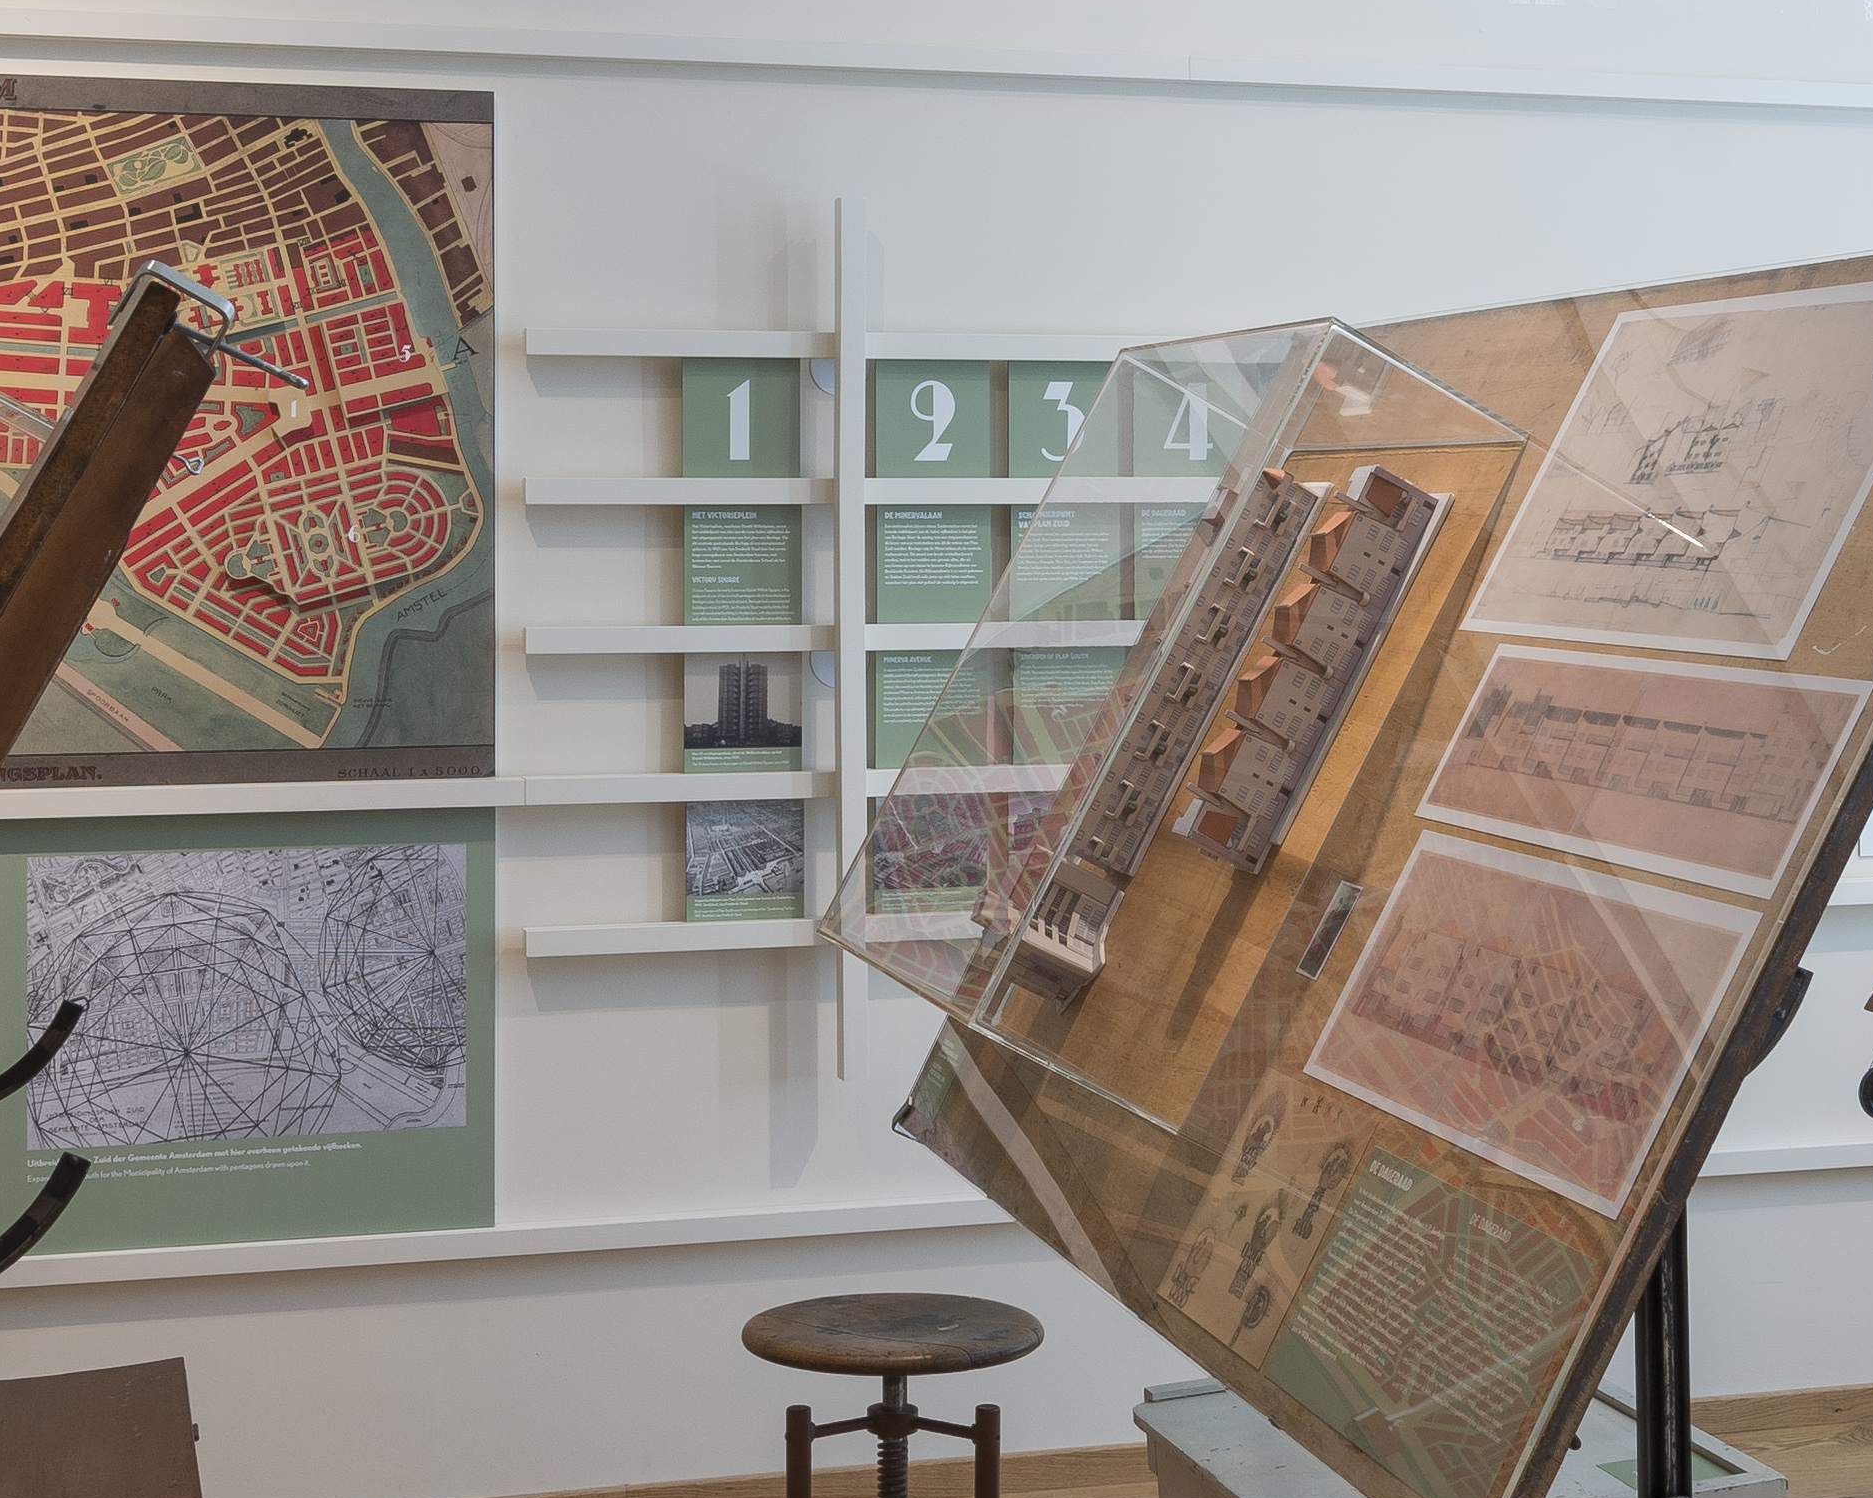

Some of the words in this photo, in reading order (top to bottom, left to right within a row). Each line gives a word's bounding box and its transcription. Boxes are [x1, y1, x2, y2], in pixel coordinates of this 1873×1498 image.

[399, 344, 411, 362] 5
[726, 379, 751, 461] 1
[909, 380, 958, 462] 2
[1041, 380, 1085, 462] 3
[1163, 382, 1214, 461] 4
[895, 511, 943, 520] MINERVALAAN
[347, 525, 361, 543] 6
[692, 576, 717, 584] VICTORY
[396, 590, 448, 622] AMSTEL
[85, 688, 131, 723] SPOORBAAN
[150, 685, 173, 705] PARK
[337, 767, 401, 779] SCHAAL
[93, 1155, 111, 1163] Zuid
[112, 1154, 126, 1162] der
[127, 1153, 167, 1161] Gemeente
[168, 1150, 213, 1159] Amsterdam
[246, 1146, 281, 1154] overheen
[282, 1143, 321, 1153] getekende
[322, 1141, 362, 1150] vijfhoeken.
